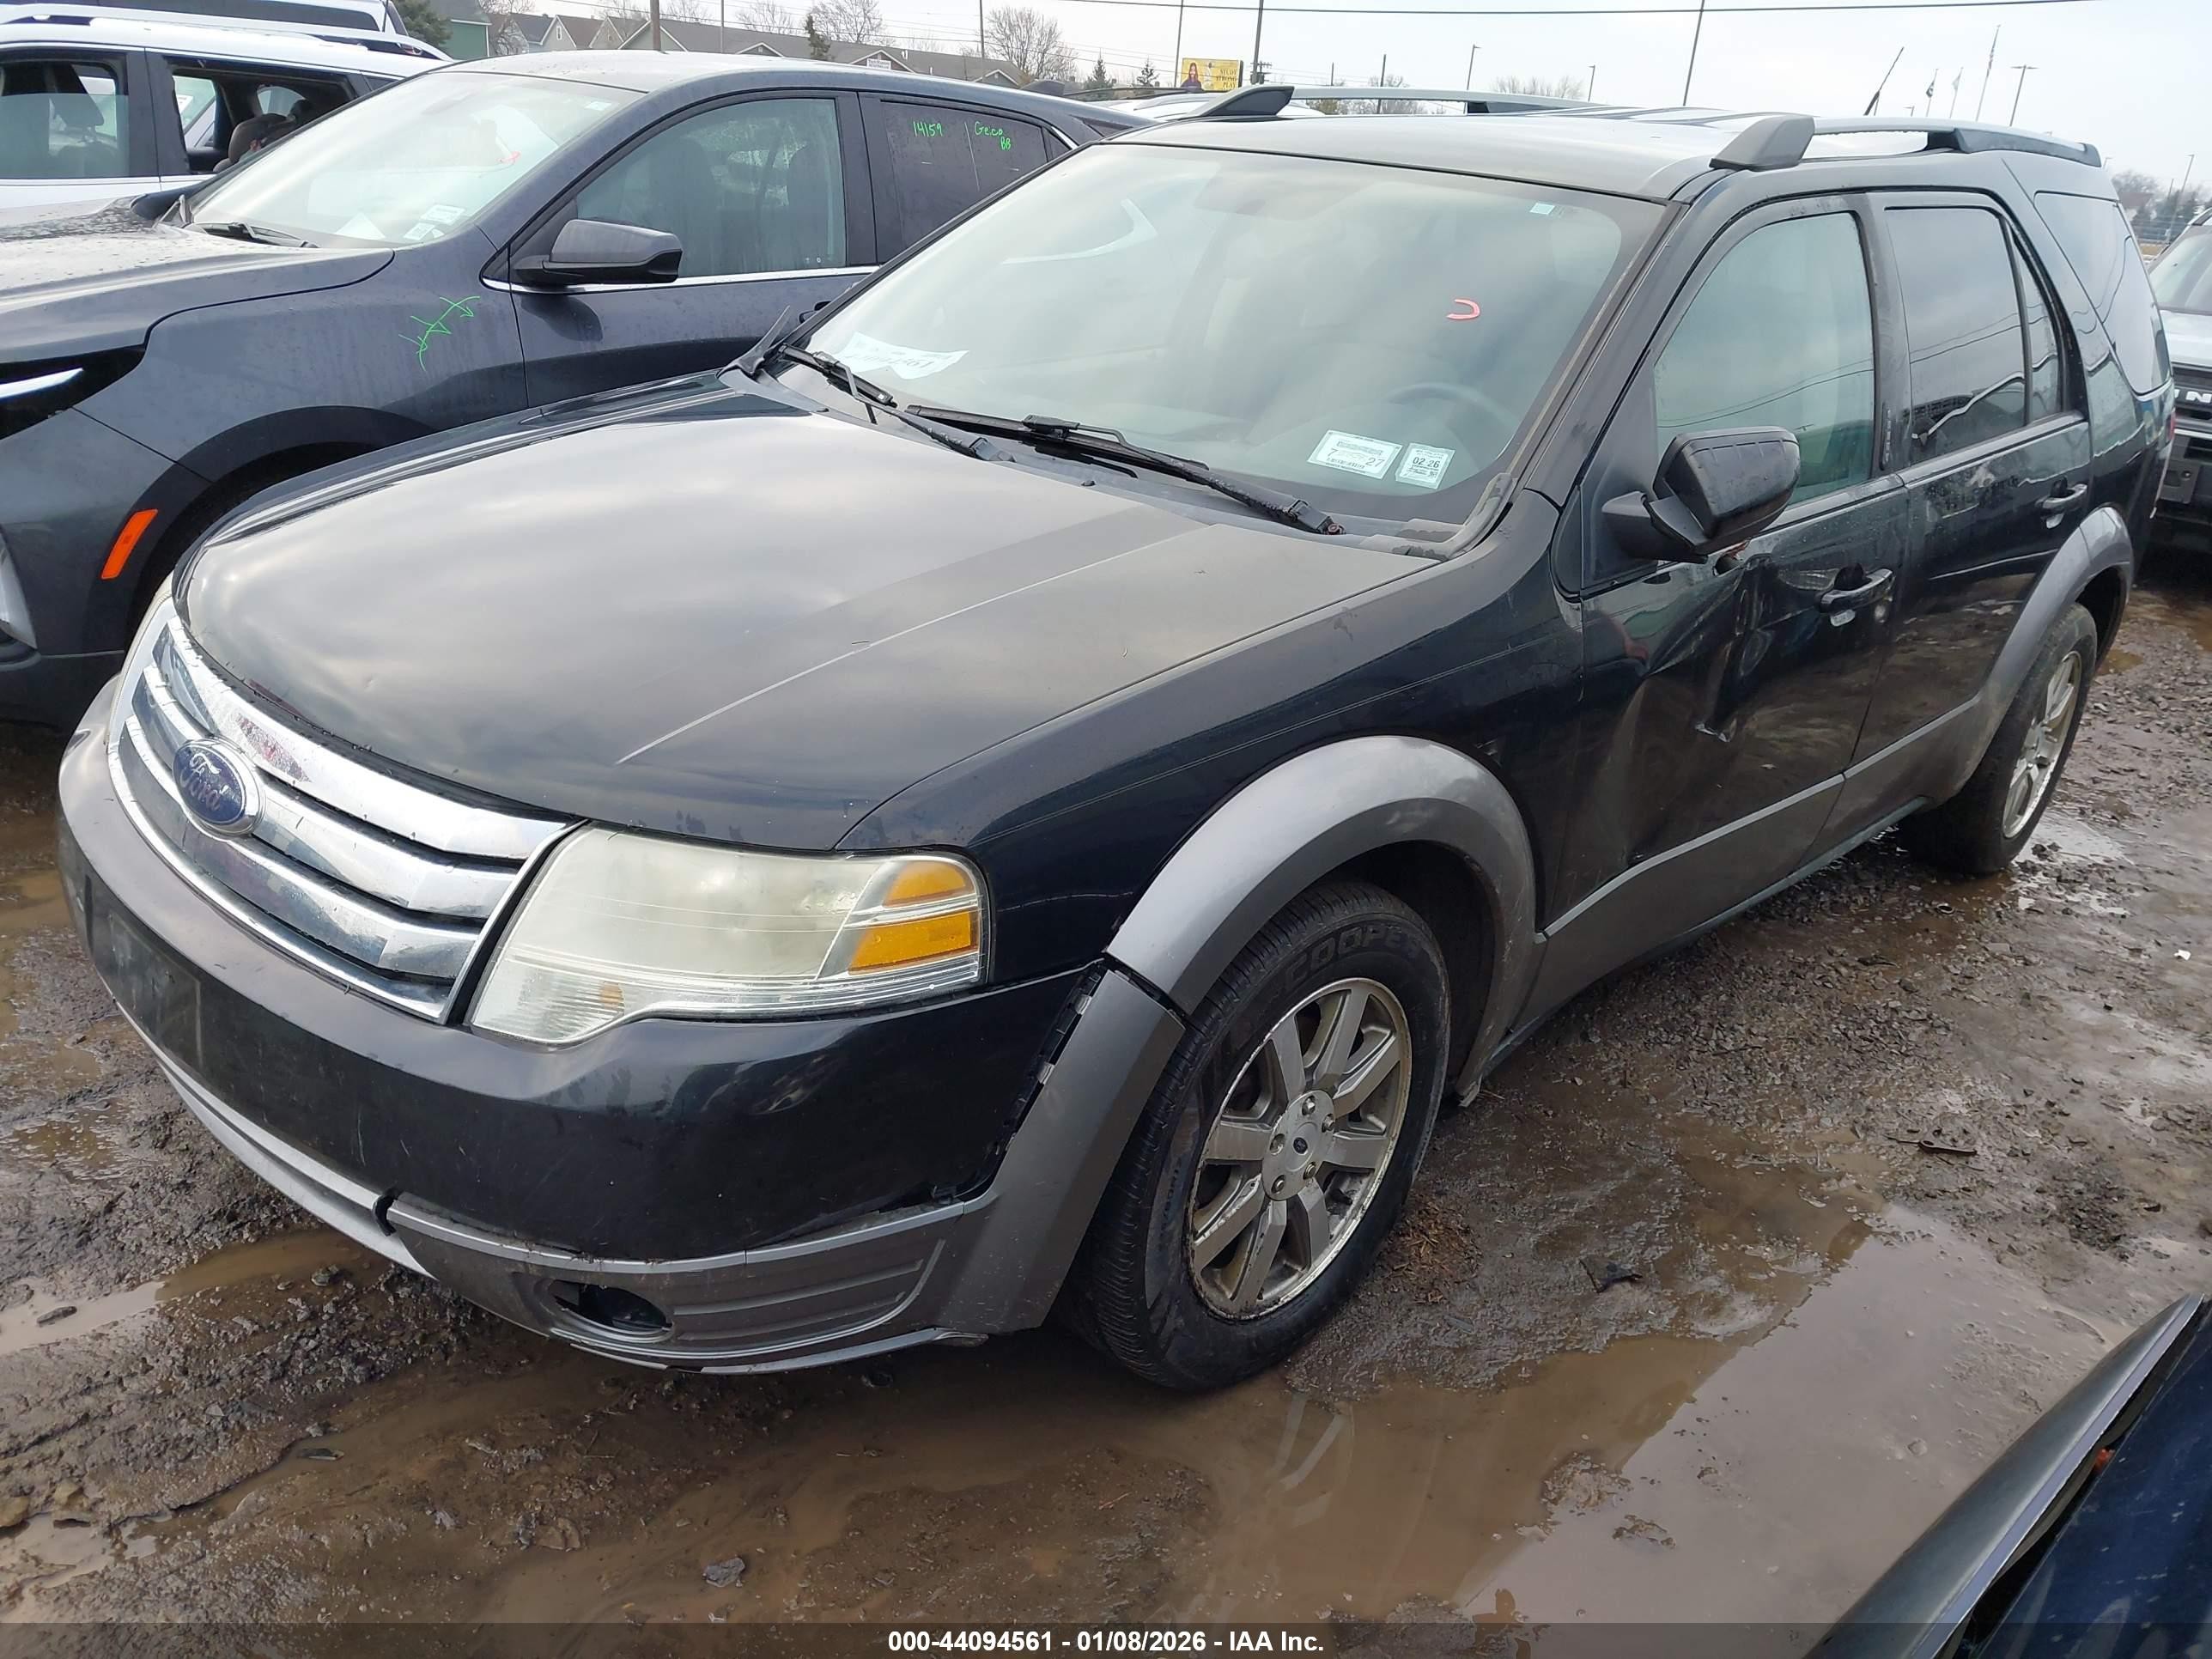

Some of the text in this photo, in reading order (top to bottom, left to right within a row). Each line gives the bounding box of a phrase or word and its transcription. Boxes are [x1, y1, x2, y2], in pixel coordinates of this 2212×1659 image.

[913, 121, 943, 137] 14159
[1365, 457, 1385, 467] 27
[179, 752, 229, 811] Ford
[1286, 923, 1421, 988] COOPER
